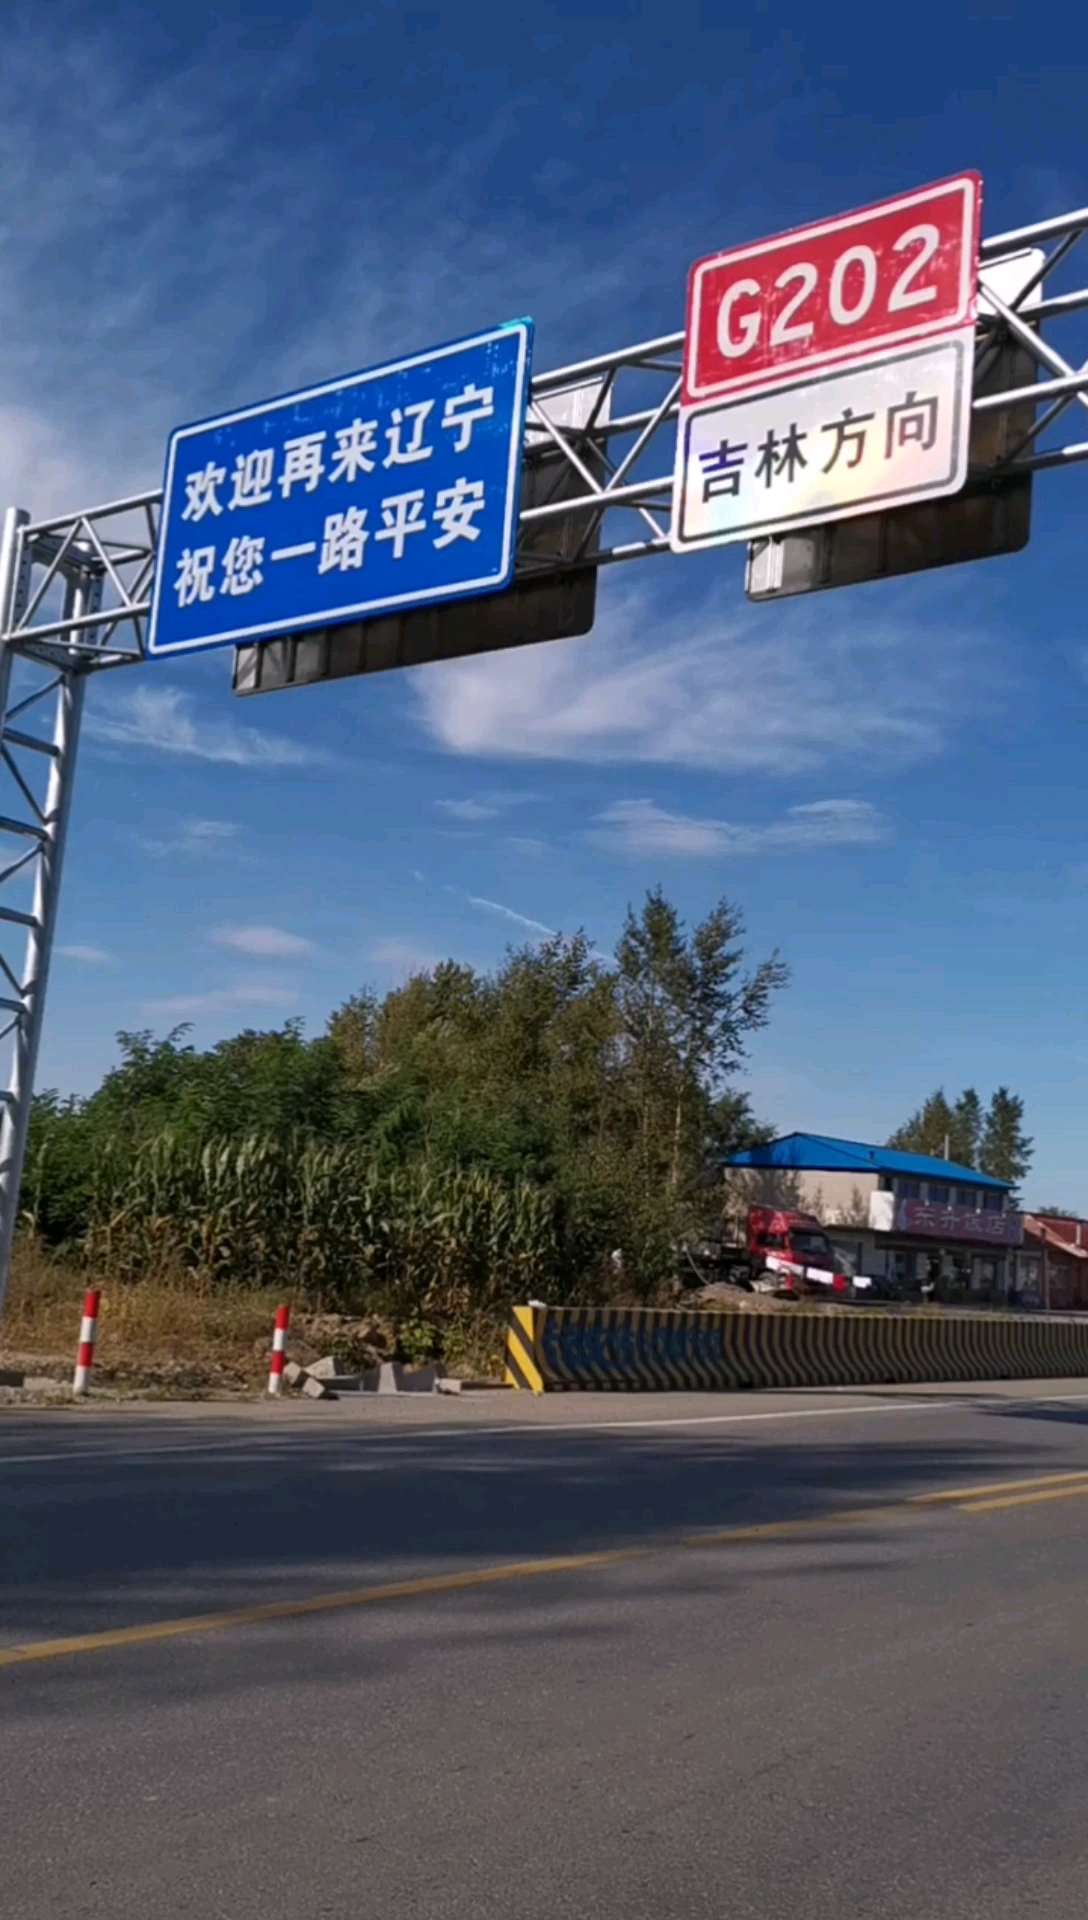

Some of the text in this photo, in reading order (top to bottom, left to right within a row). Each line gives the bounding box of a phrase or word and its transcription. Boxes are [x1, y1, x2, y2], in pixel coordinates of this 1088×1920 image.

[716, 223, 940, 359] G202
[181, 383, 494, 522] 欢迎再来辽宁
[698, 391, 939, 503] 吉林方向
[173, 477, 486, 608] 祝您一路平安
